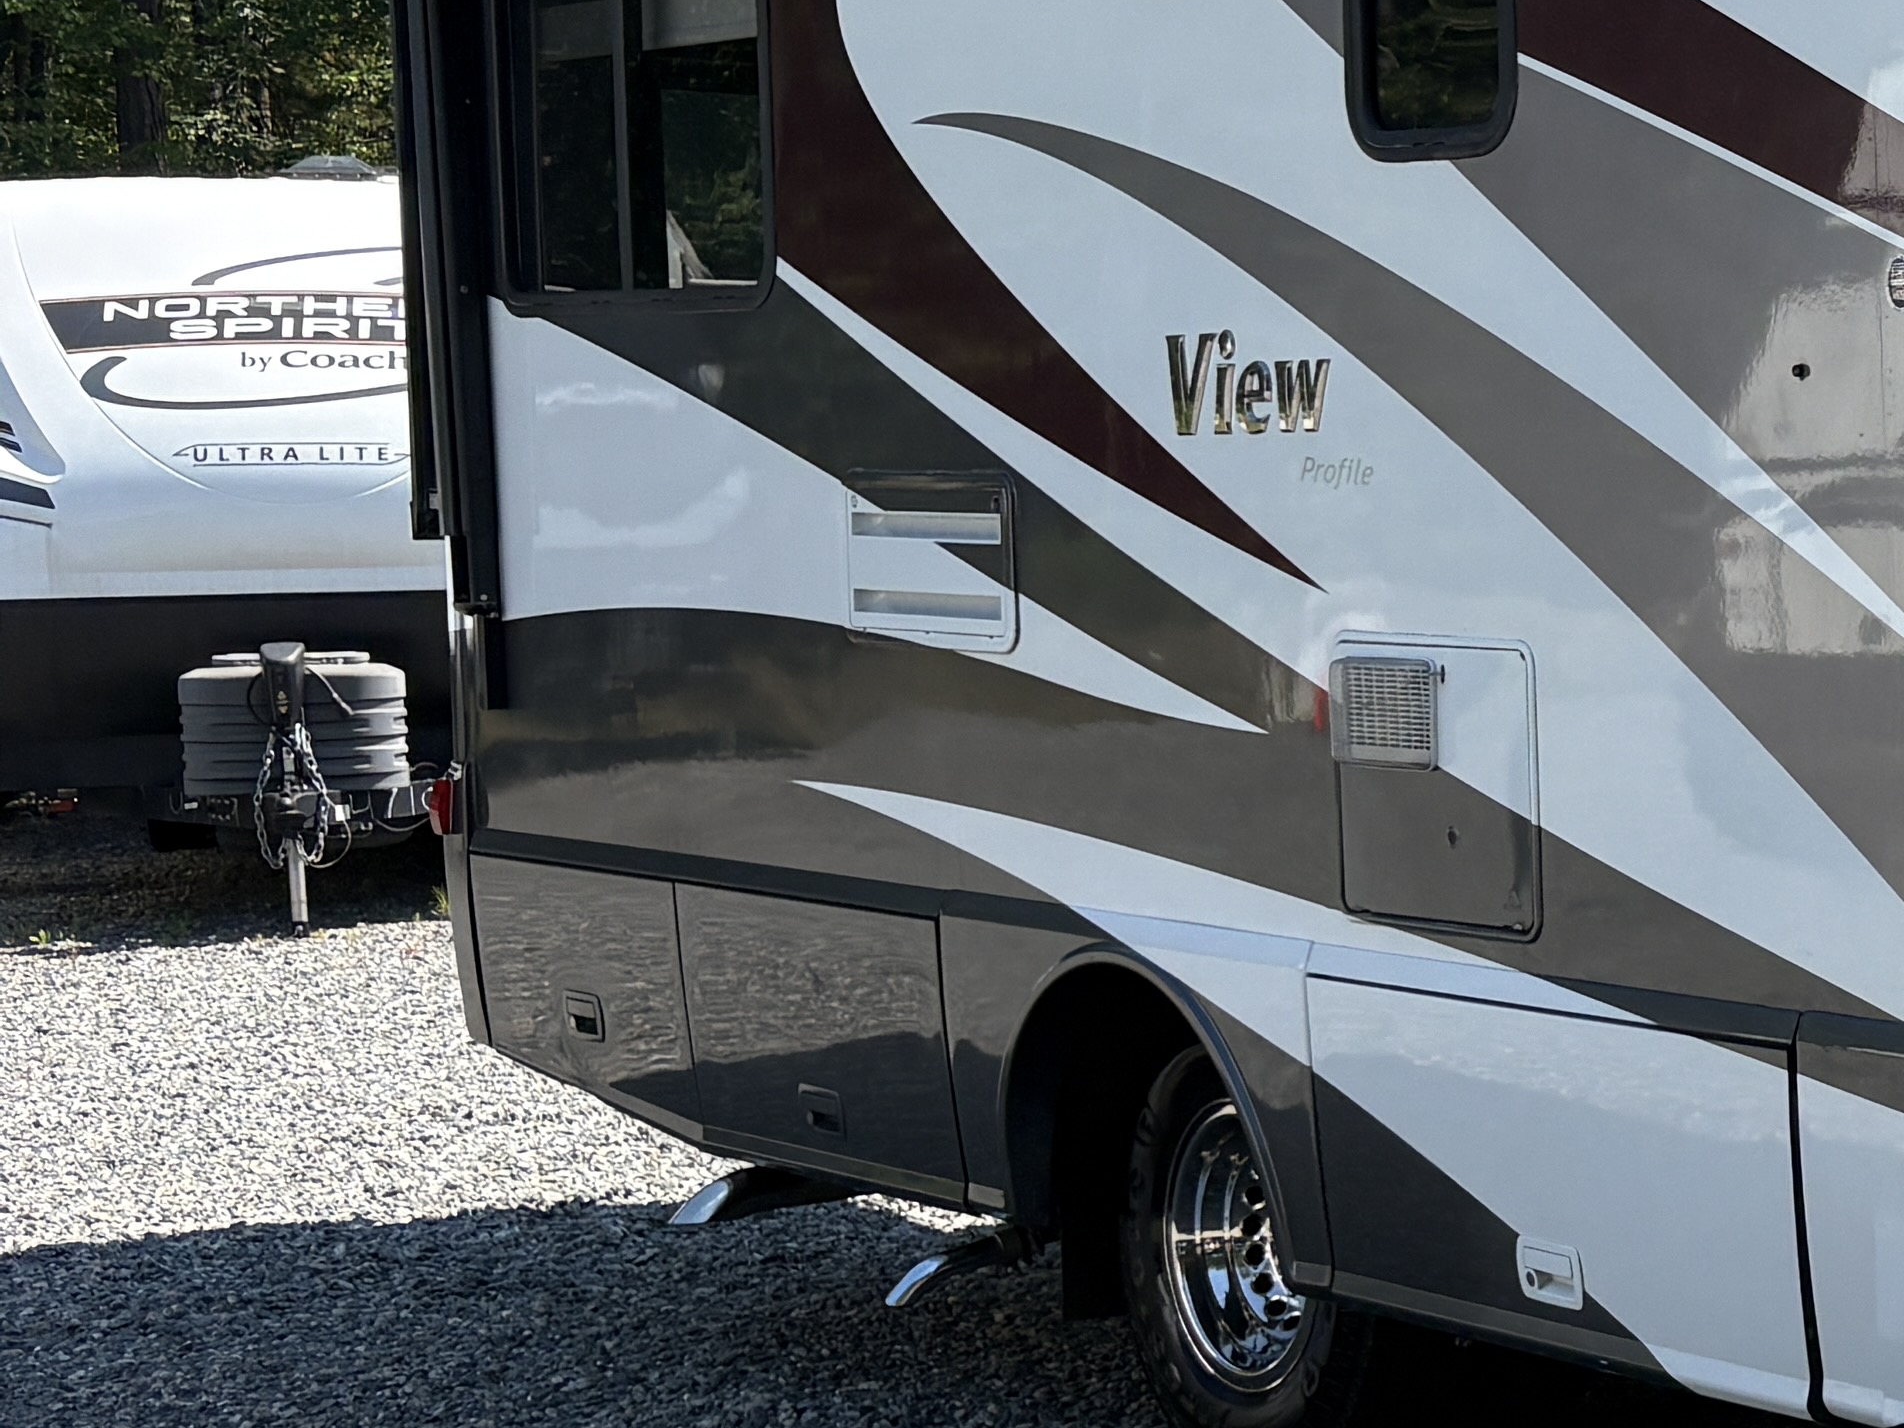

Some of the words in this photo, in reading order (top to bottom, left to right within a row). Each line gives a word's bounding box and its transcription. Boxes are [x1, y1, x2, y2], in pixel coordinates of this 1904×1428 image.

[103, 296, 406, 322] NORTHE
[241, 351, 273, 373] by
[279, 350, 409, 370] Coach
[1165, 329, 1332, 436] View
[193, 445, 299, 463] ULTRA
[319, 445, 390, 462] LITE
[1300, 456, 1375, 491] Profile
